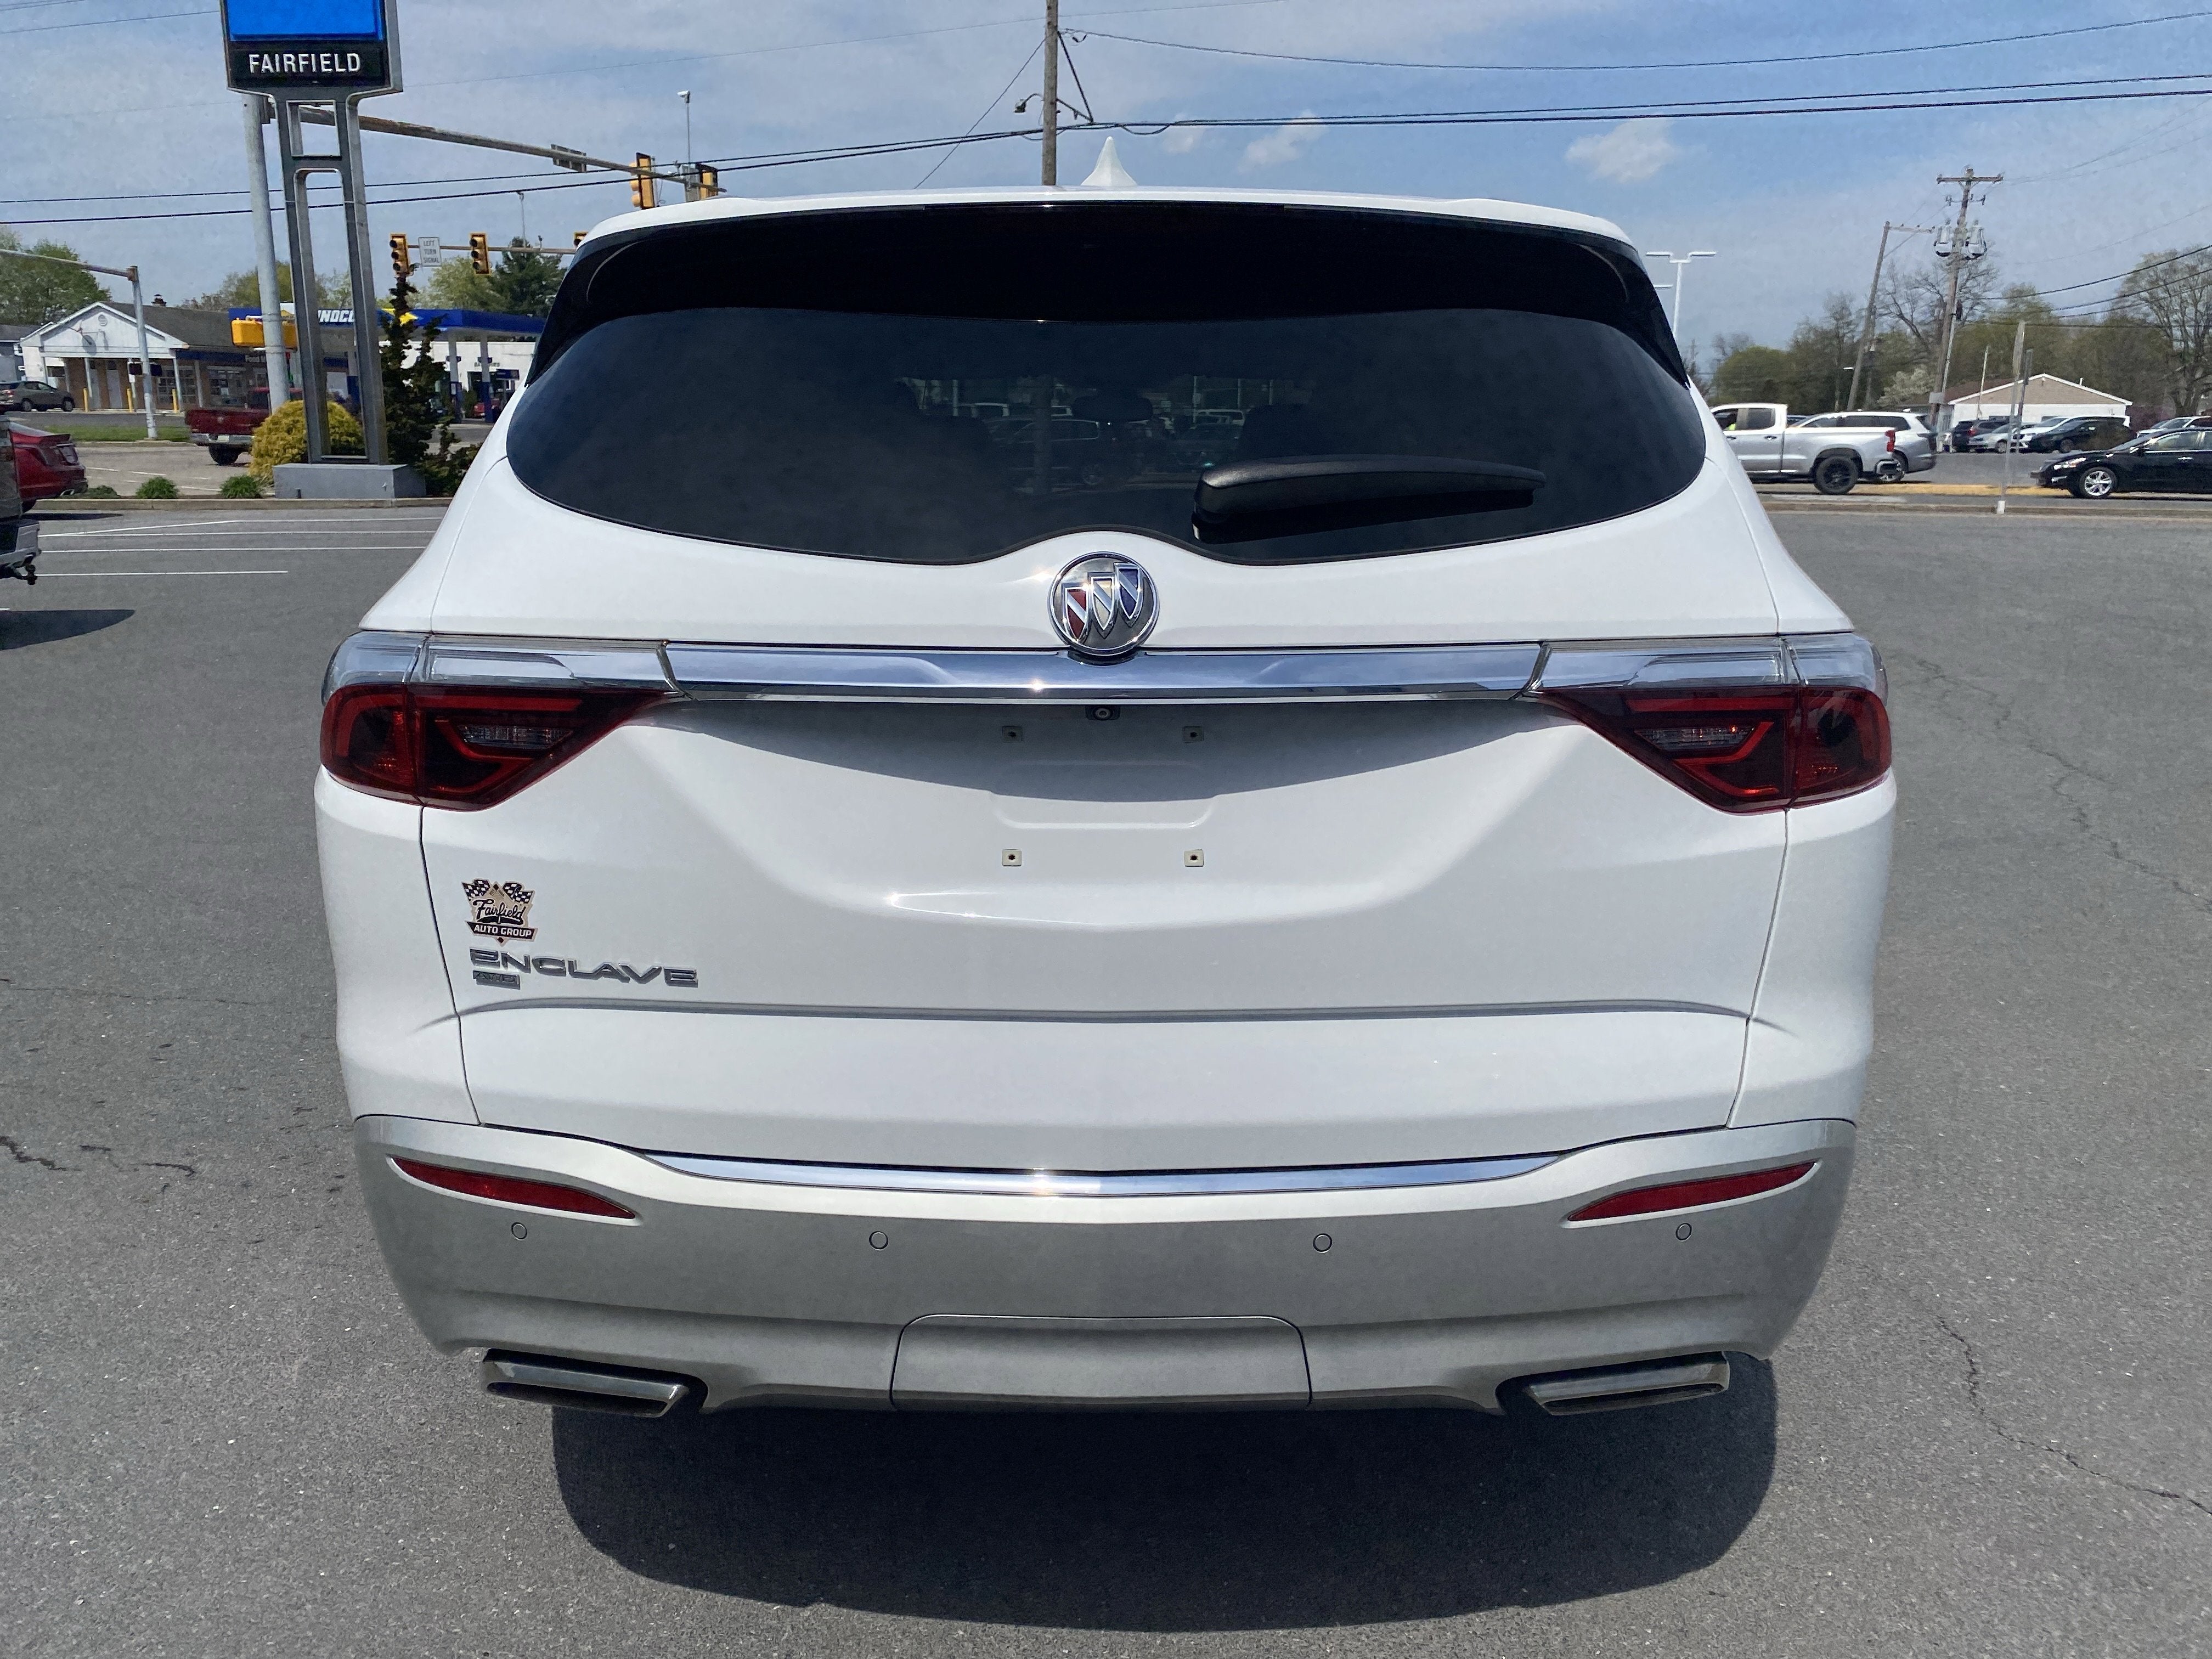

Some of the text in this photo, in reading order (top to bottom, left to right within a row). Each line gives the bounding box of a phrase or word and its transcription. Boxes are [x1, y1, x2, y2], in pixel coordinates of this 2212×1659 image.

[249, 53, 361, 73] FAIRFIELD
[472, 899, 527, 923] Fairfield
[473, 924, 532, 937] AUTO GROUP
[469, 947, 698, 988] ENCLAVE
